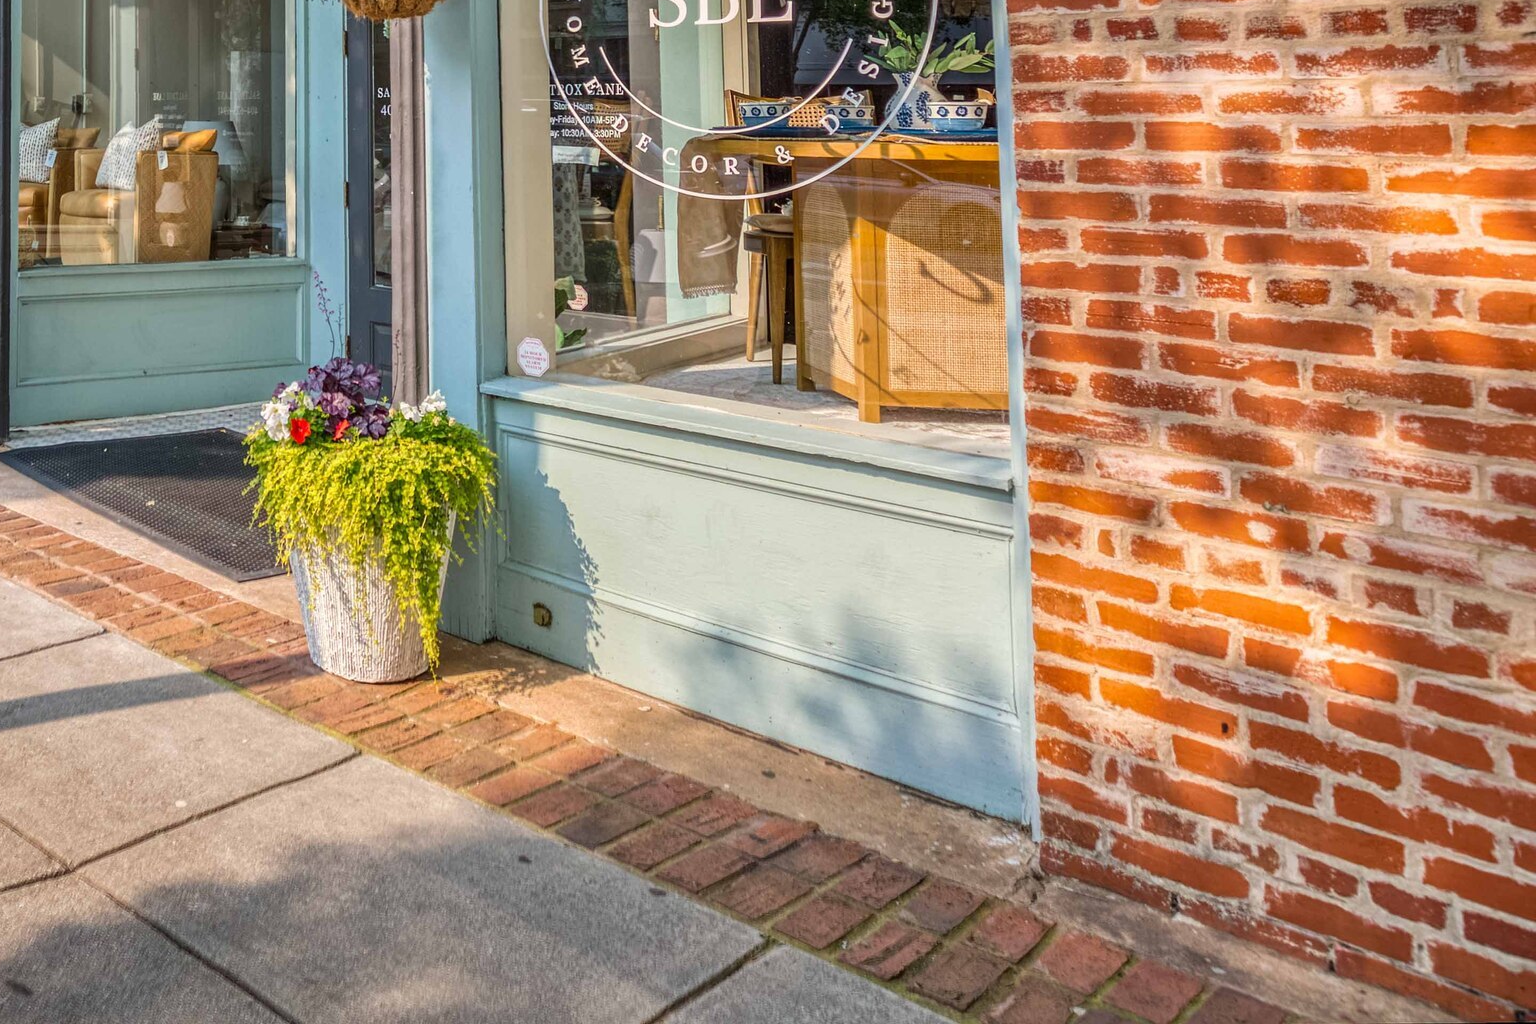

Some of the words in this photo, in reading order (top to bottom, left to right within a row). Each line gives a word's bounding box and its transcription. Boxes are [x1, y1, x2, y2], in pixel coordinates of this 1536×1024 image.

[553, 102, 572, 110] Stor
[573, 102, 594, 110] Hours
[611, 113, 740, 175] DECOR
[775, 145, 795, 164] &
